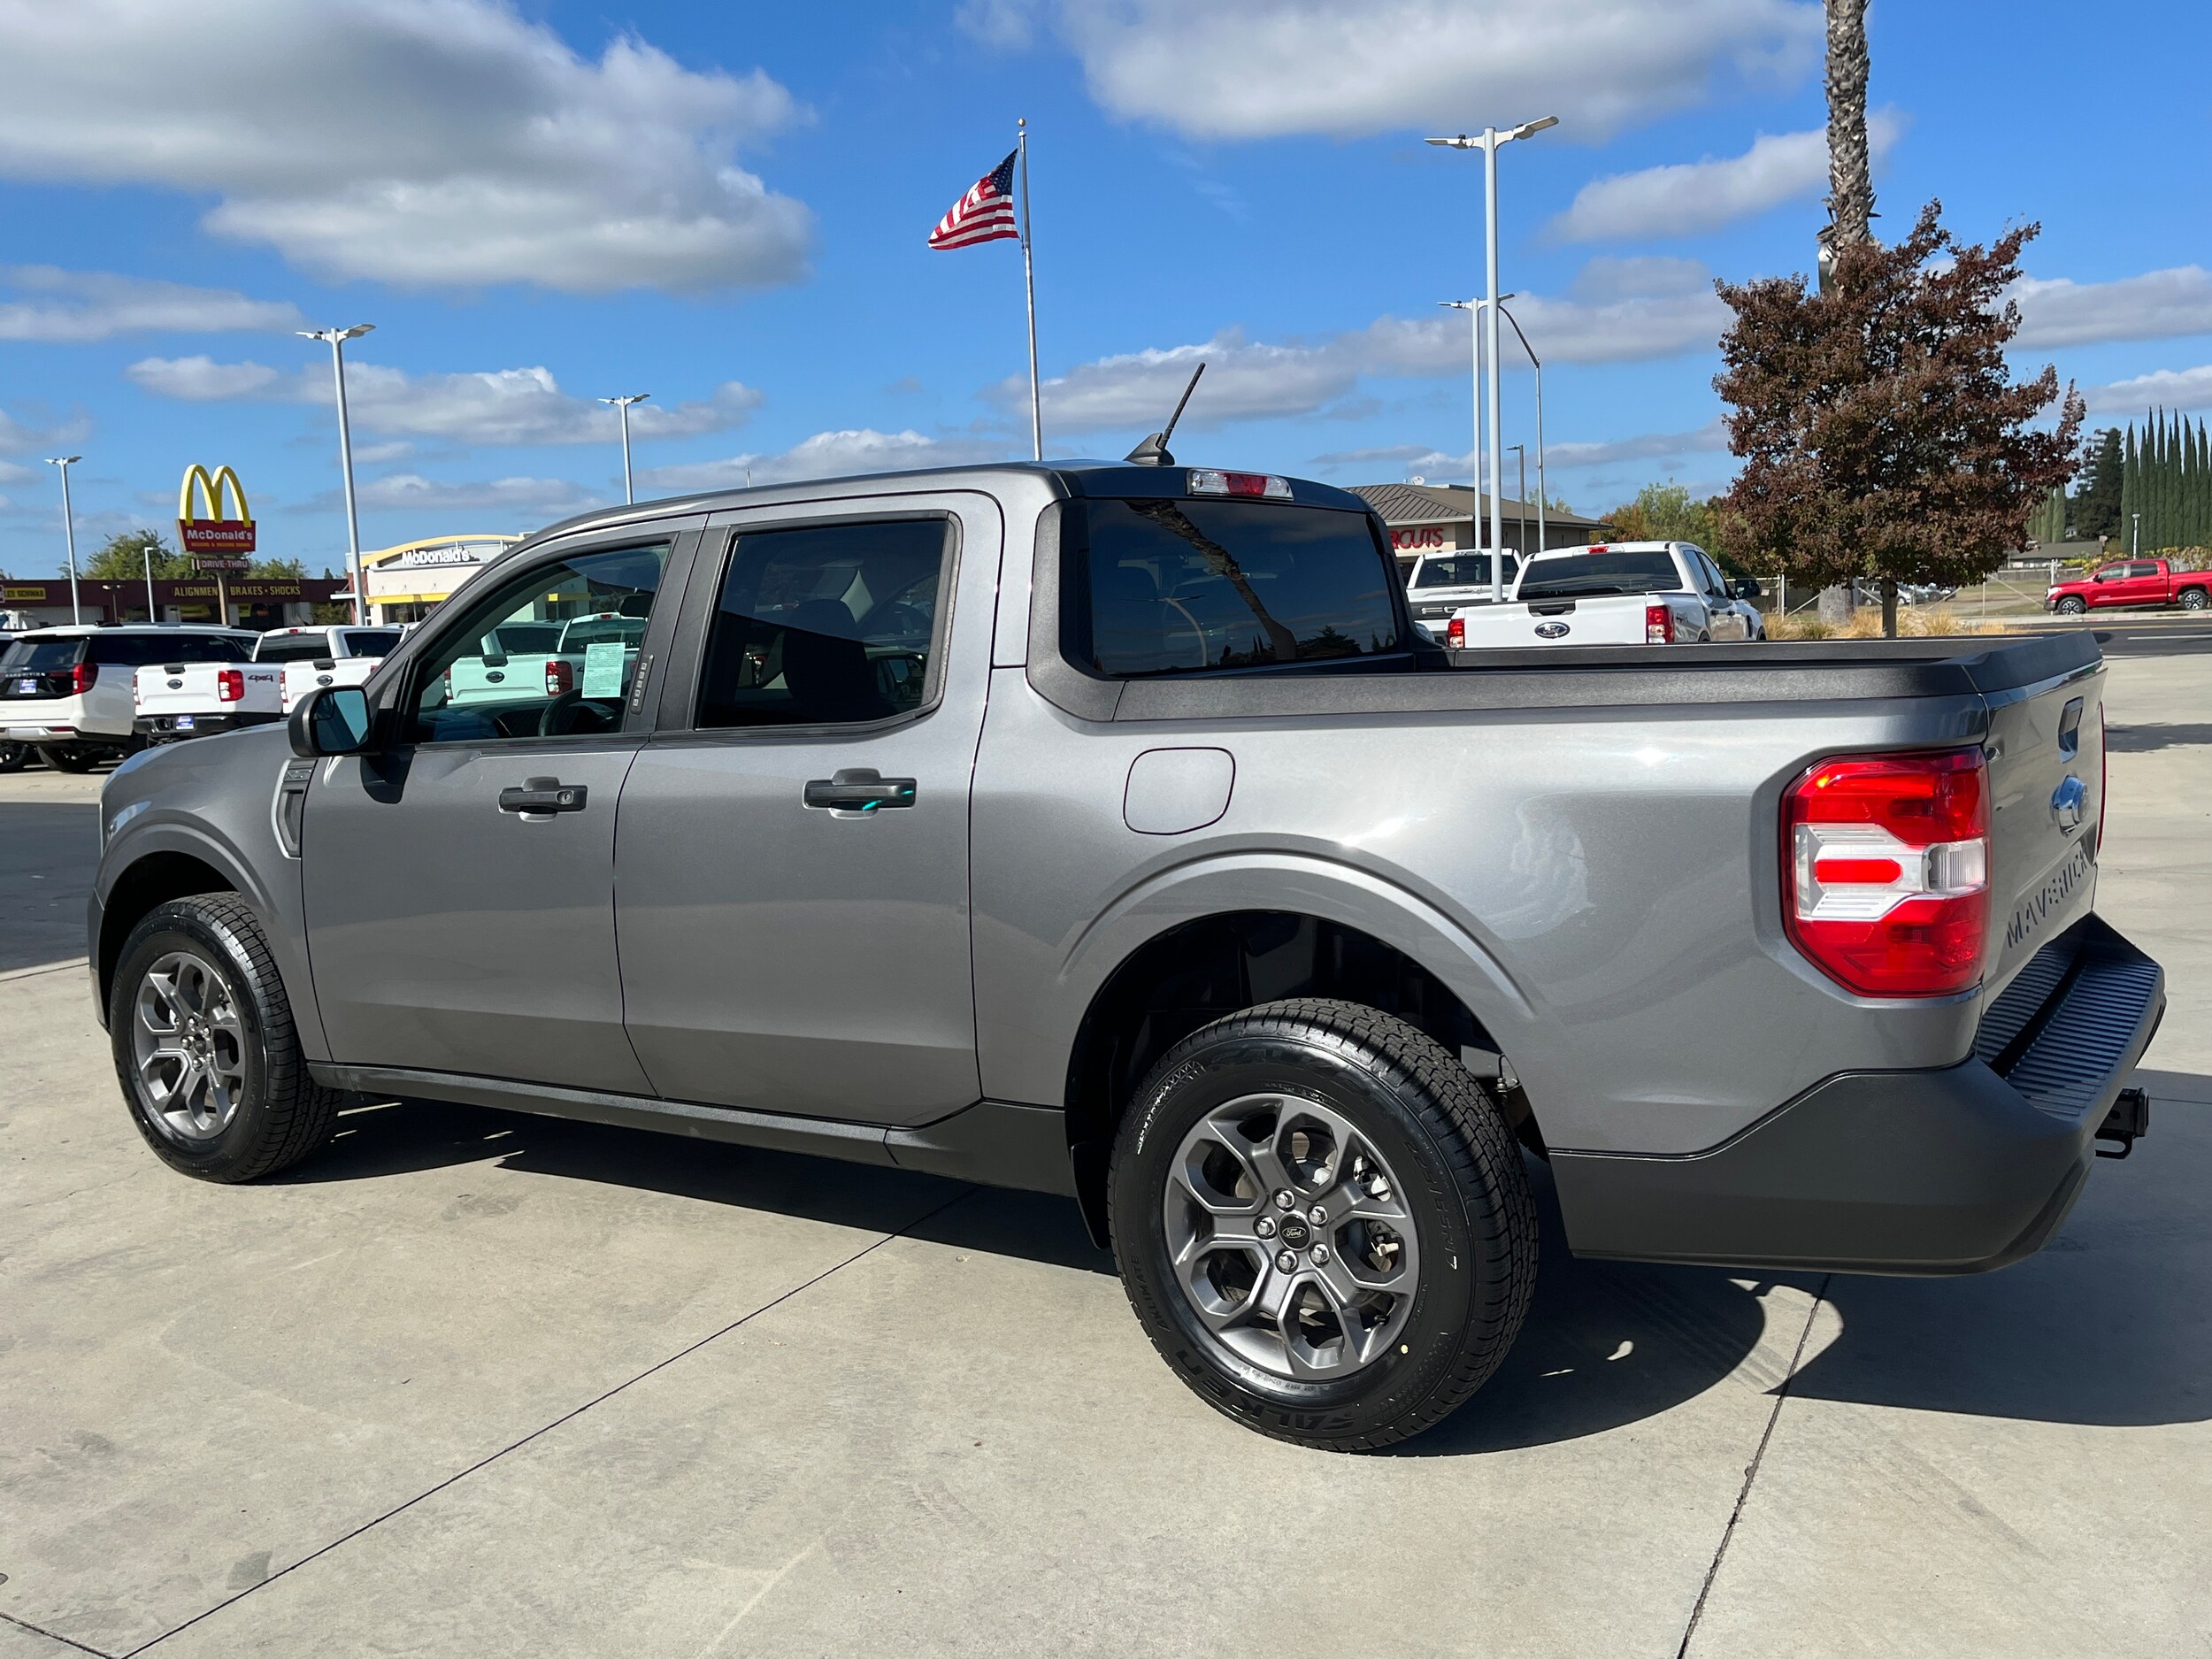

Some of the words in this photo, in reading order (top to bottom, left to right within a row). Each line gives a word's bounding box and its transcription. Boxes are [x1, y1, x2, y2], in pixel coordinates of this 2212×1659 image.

[187, 529, 253, 541] McDonald's
[402, 547, 470, 565] McDonald's
[173, 586, 219, 597] ALIGNMEN
[229, 585, 264, 596] BRAKES
[269, 585, 301, 595] SHOCKS
[2006, 849, 2088, 949] MAVERICK
